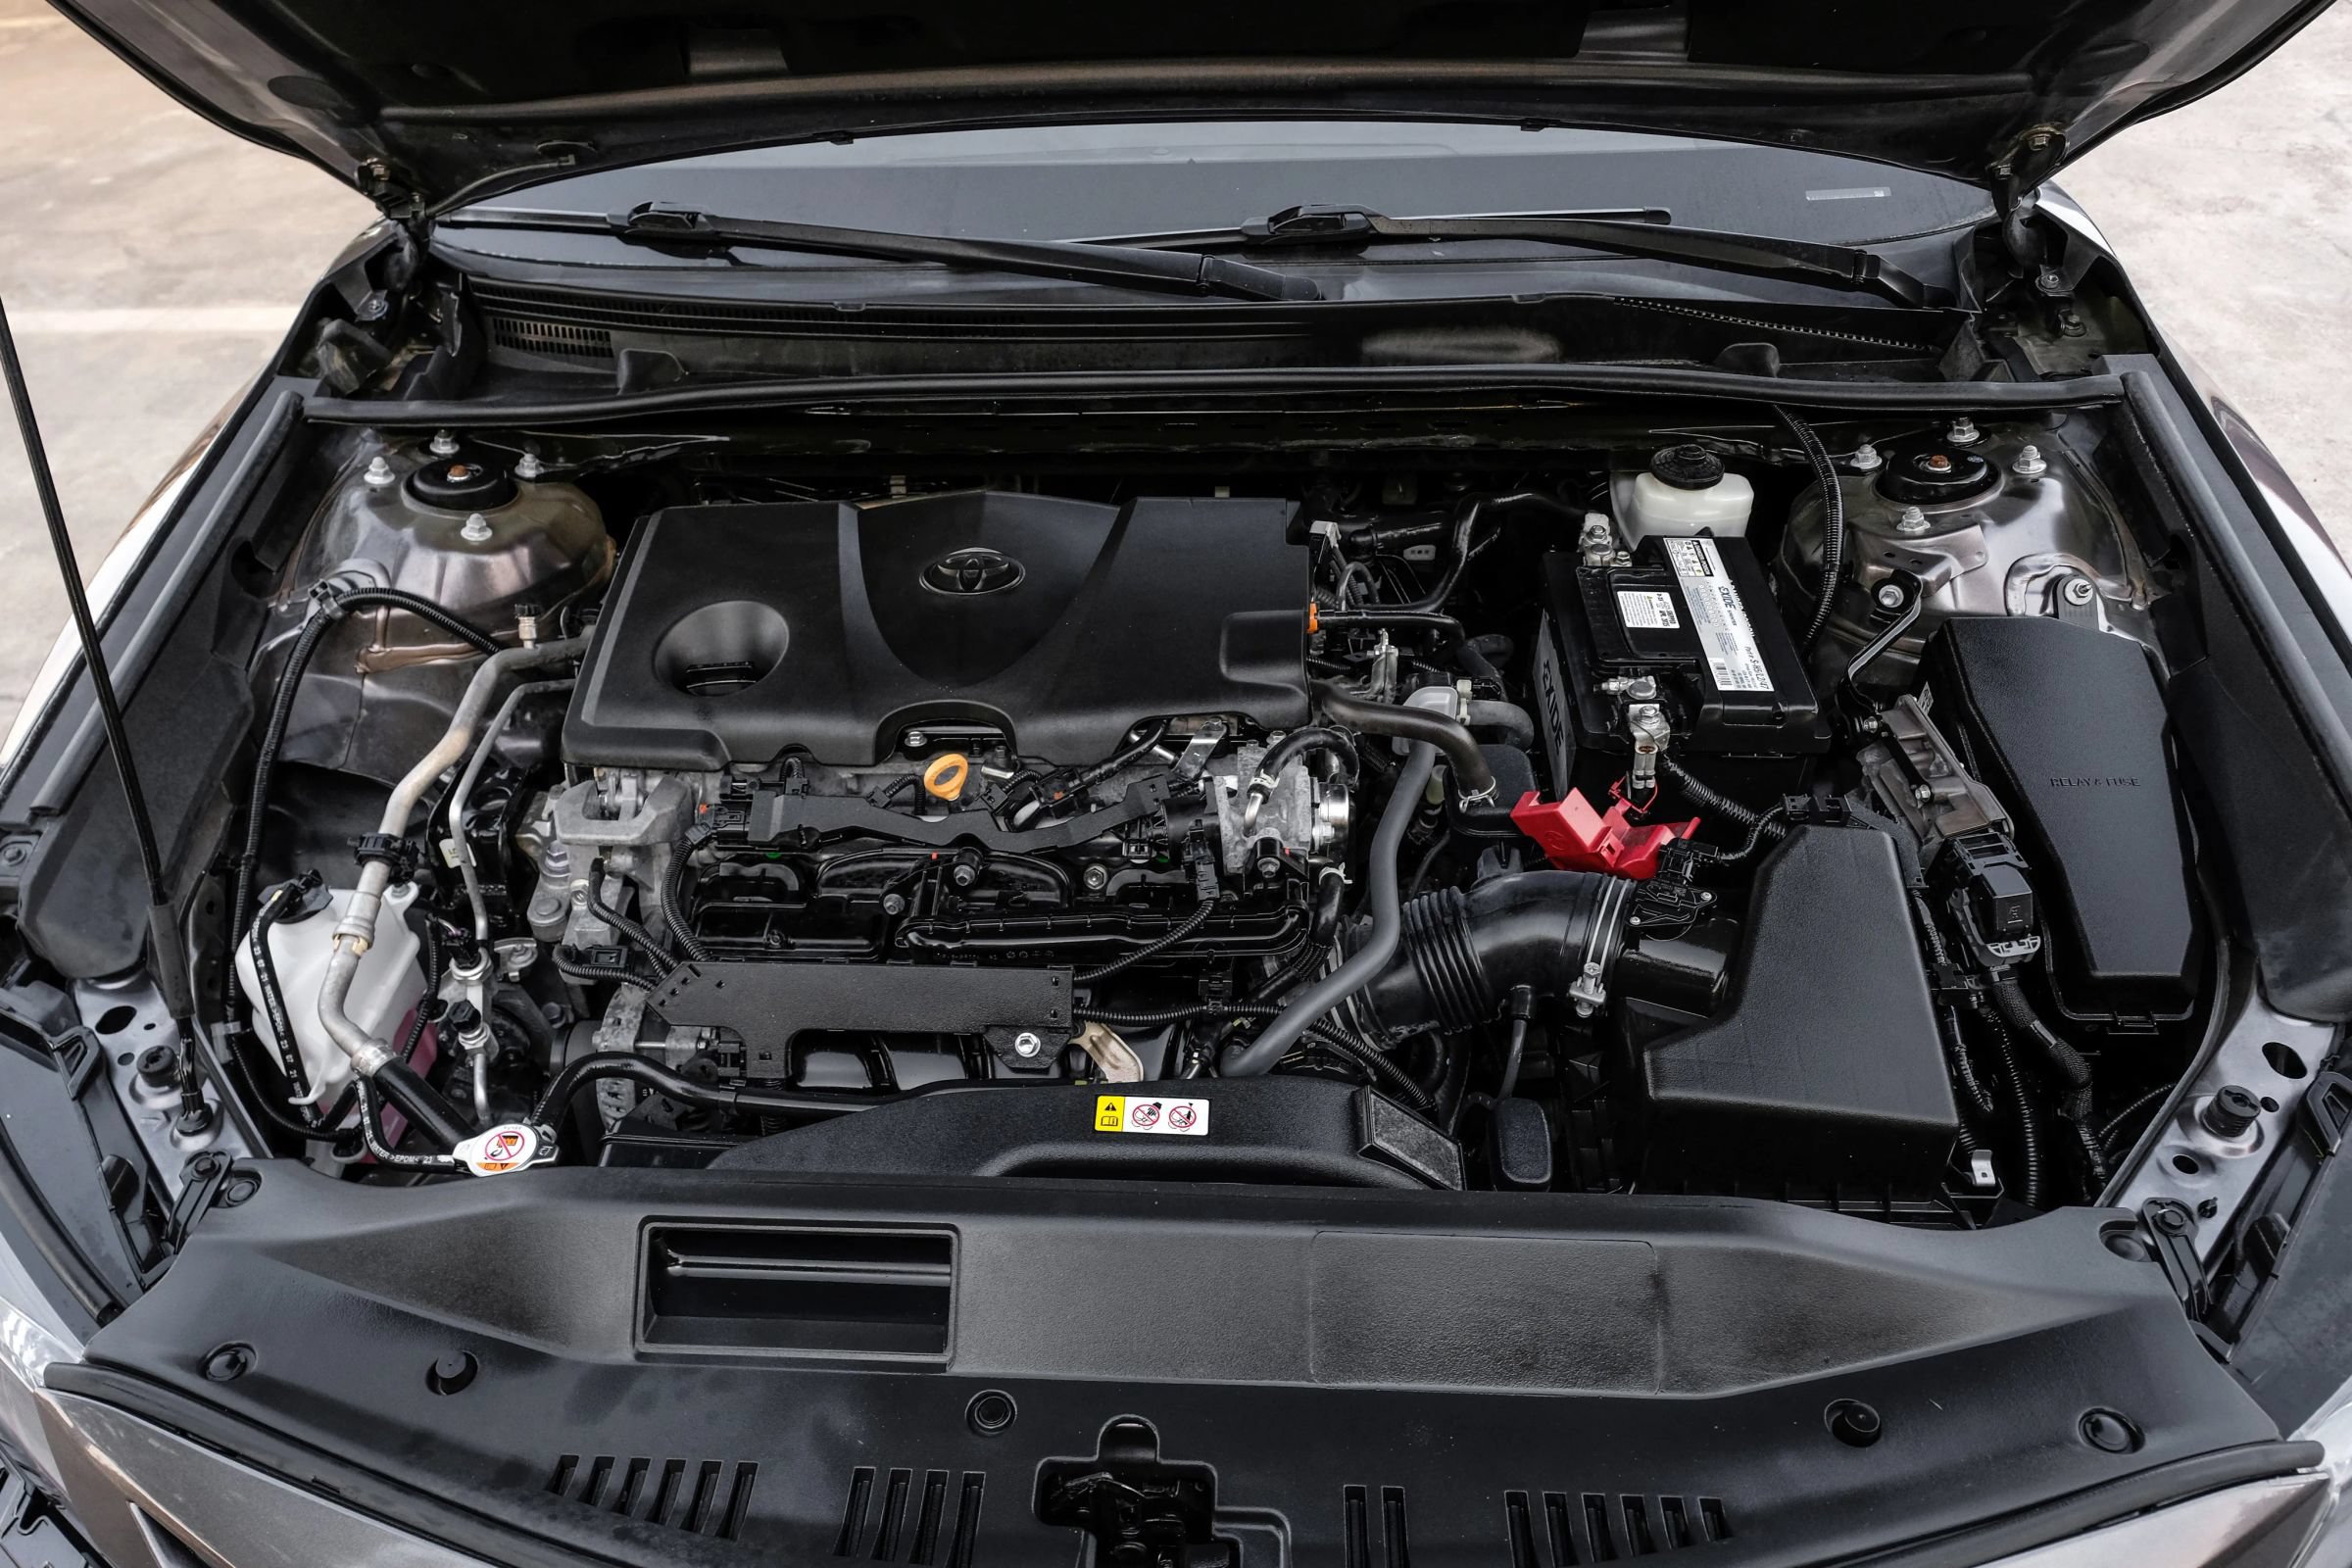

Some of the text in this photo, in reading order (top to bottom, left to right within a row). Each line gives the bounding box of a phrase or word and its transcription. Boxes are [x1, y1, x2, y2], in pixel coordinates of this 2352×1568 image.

[1717, 586, 1736, 609] EXIDE
[1543, 659, 1564, 756] EXIDE
[2050, 777, 2141, 787] RELAY & FUSE
[265, 984, 277, 1009] WATER
[280, 1040, 289, 1050] 23
[289, 1069, 298, 1078] 21
[371, 1140, 390, 1158] WATER
[390, 1154, 419, 1163] >EPDM<
